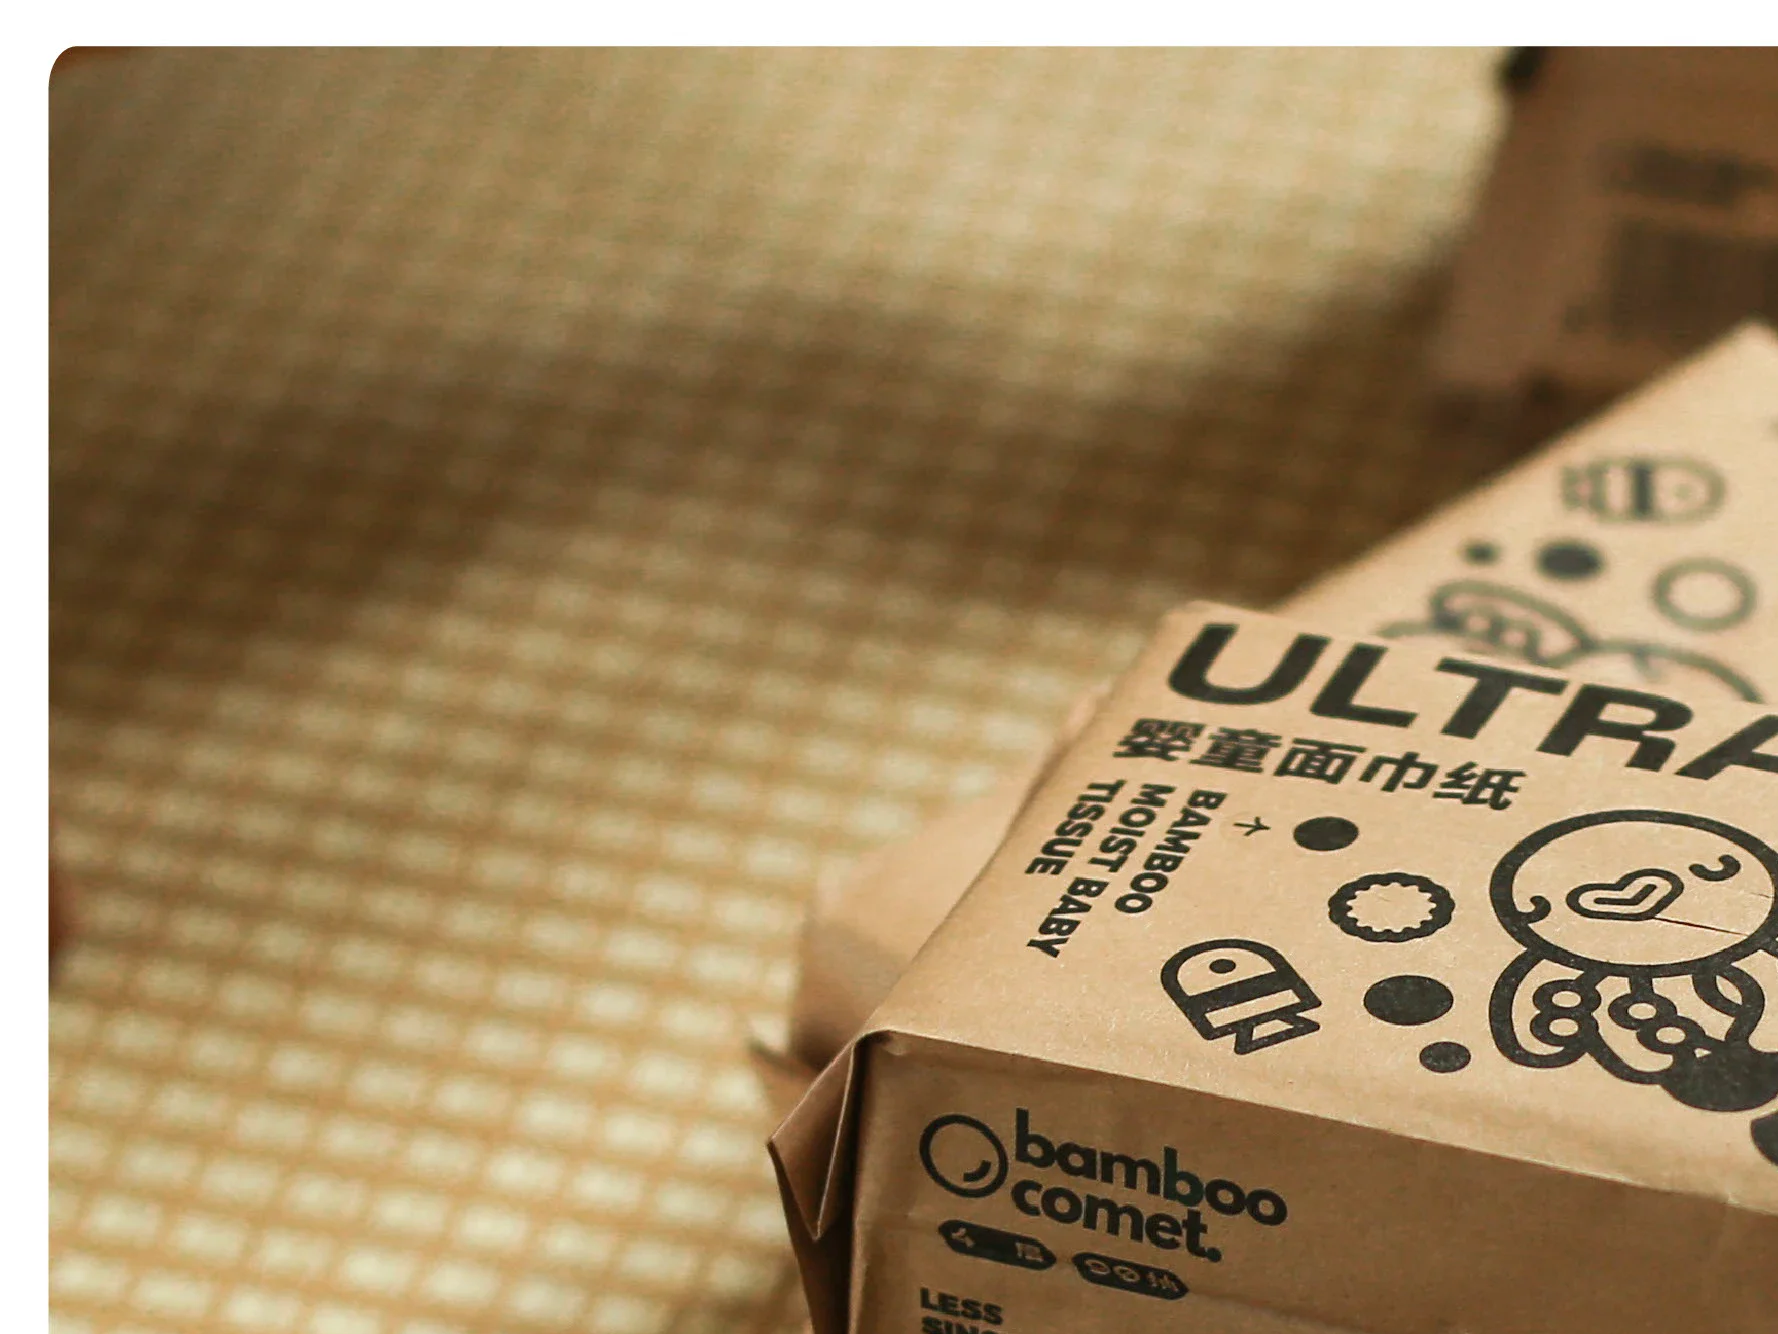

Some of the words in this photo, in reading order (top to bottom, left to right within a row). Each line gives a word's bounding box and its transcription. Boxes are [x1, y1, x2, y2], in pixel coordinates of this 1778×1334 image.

[1112, 717, 1527, 811] 婴童面巾纸
[1024, 779, 1127, 876] TISSUE
[1087, 783, 1177, 873] MOIST
[1113, 789, 1229, 914] BAMBOO
[1026, 876, 1110, 959] BABY
[1014, 1106, 1288, 1227] bamboo
[919, 1287, 1004, 1326] LESS
